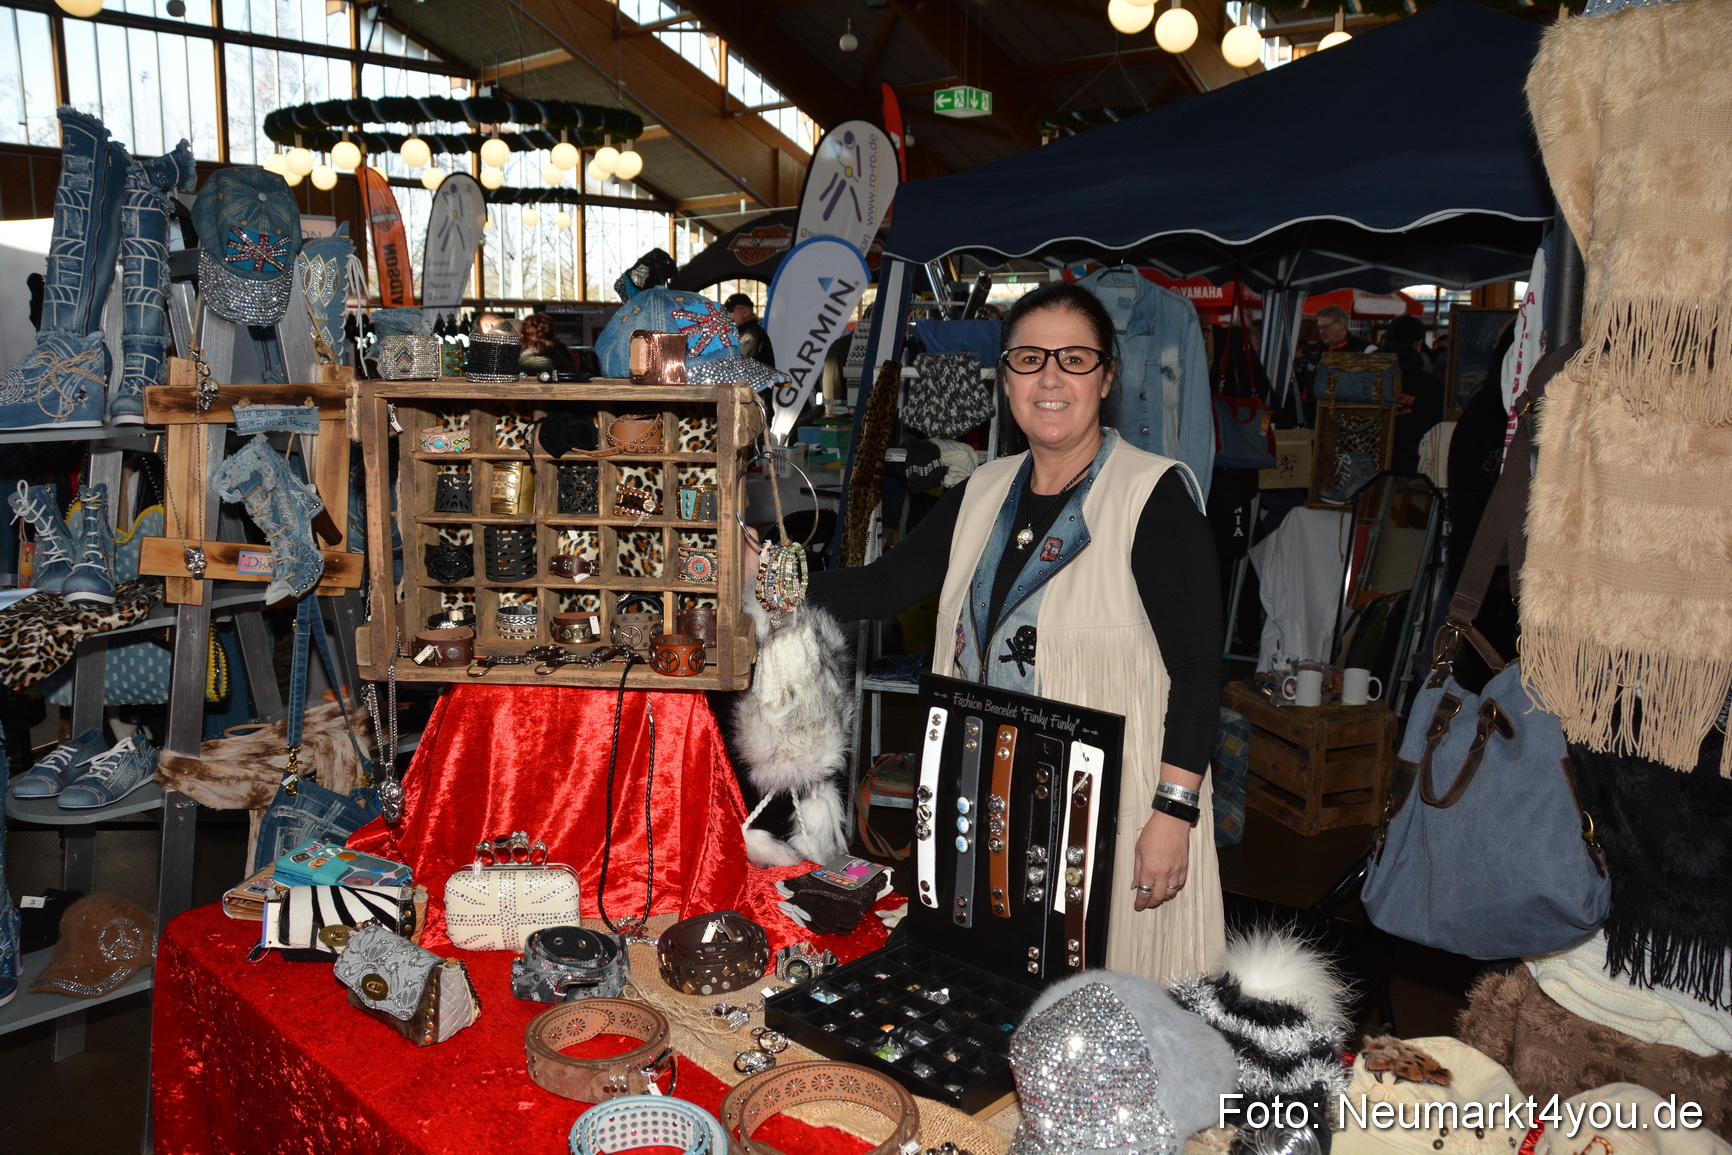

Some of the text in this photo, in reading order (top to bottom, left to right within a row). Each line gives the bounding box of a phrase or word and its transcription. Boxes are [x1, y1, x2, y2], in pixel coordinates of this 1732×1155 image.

[866, 132, 879, 227] www.ro-ro.de
[1180, 286, 1223, 298] YAMAHA
[775, 278, 857, 408] GARMIN
[953, 692, 1081, 737] Fashion Bracelet "Funky Funky"
